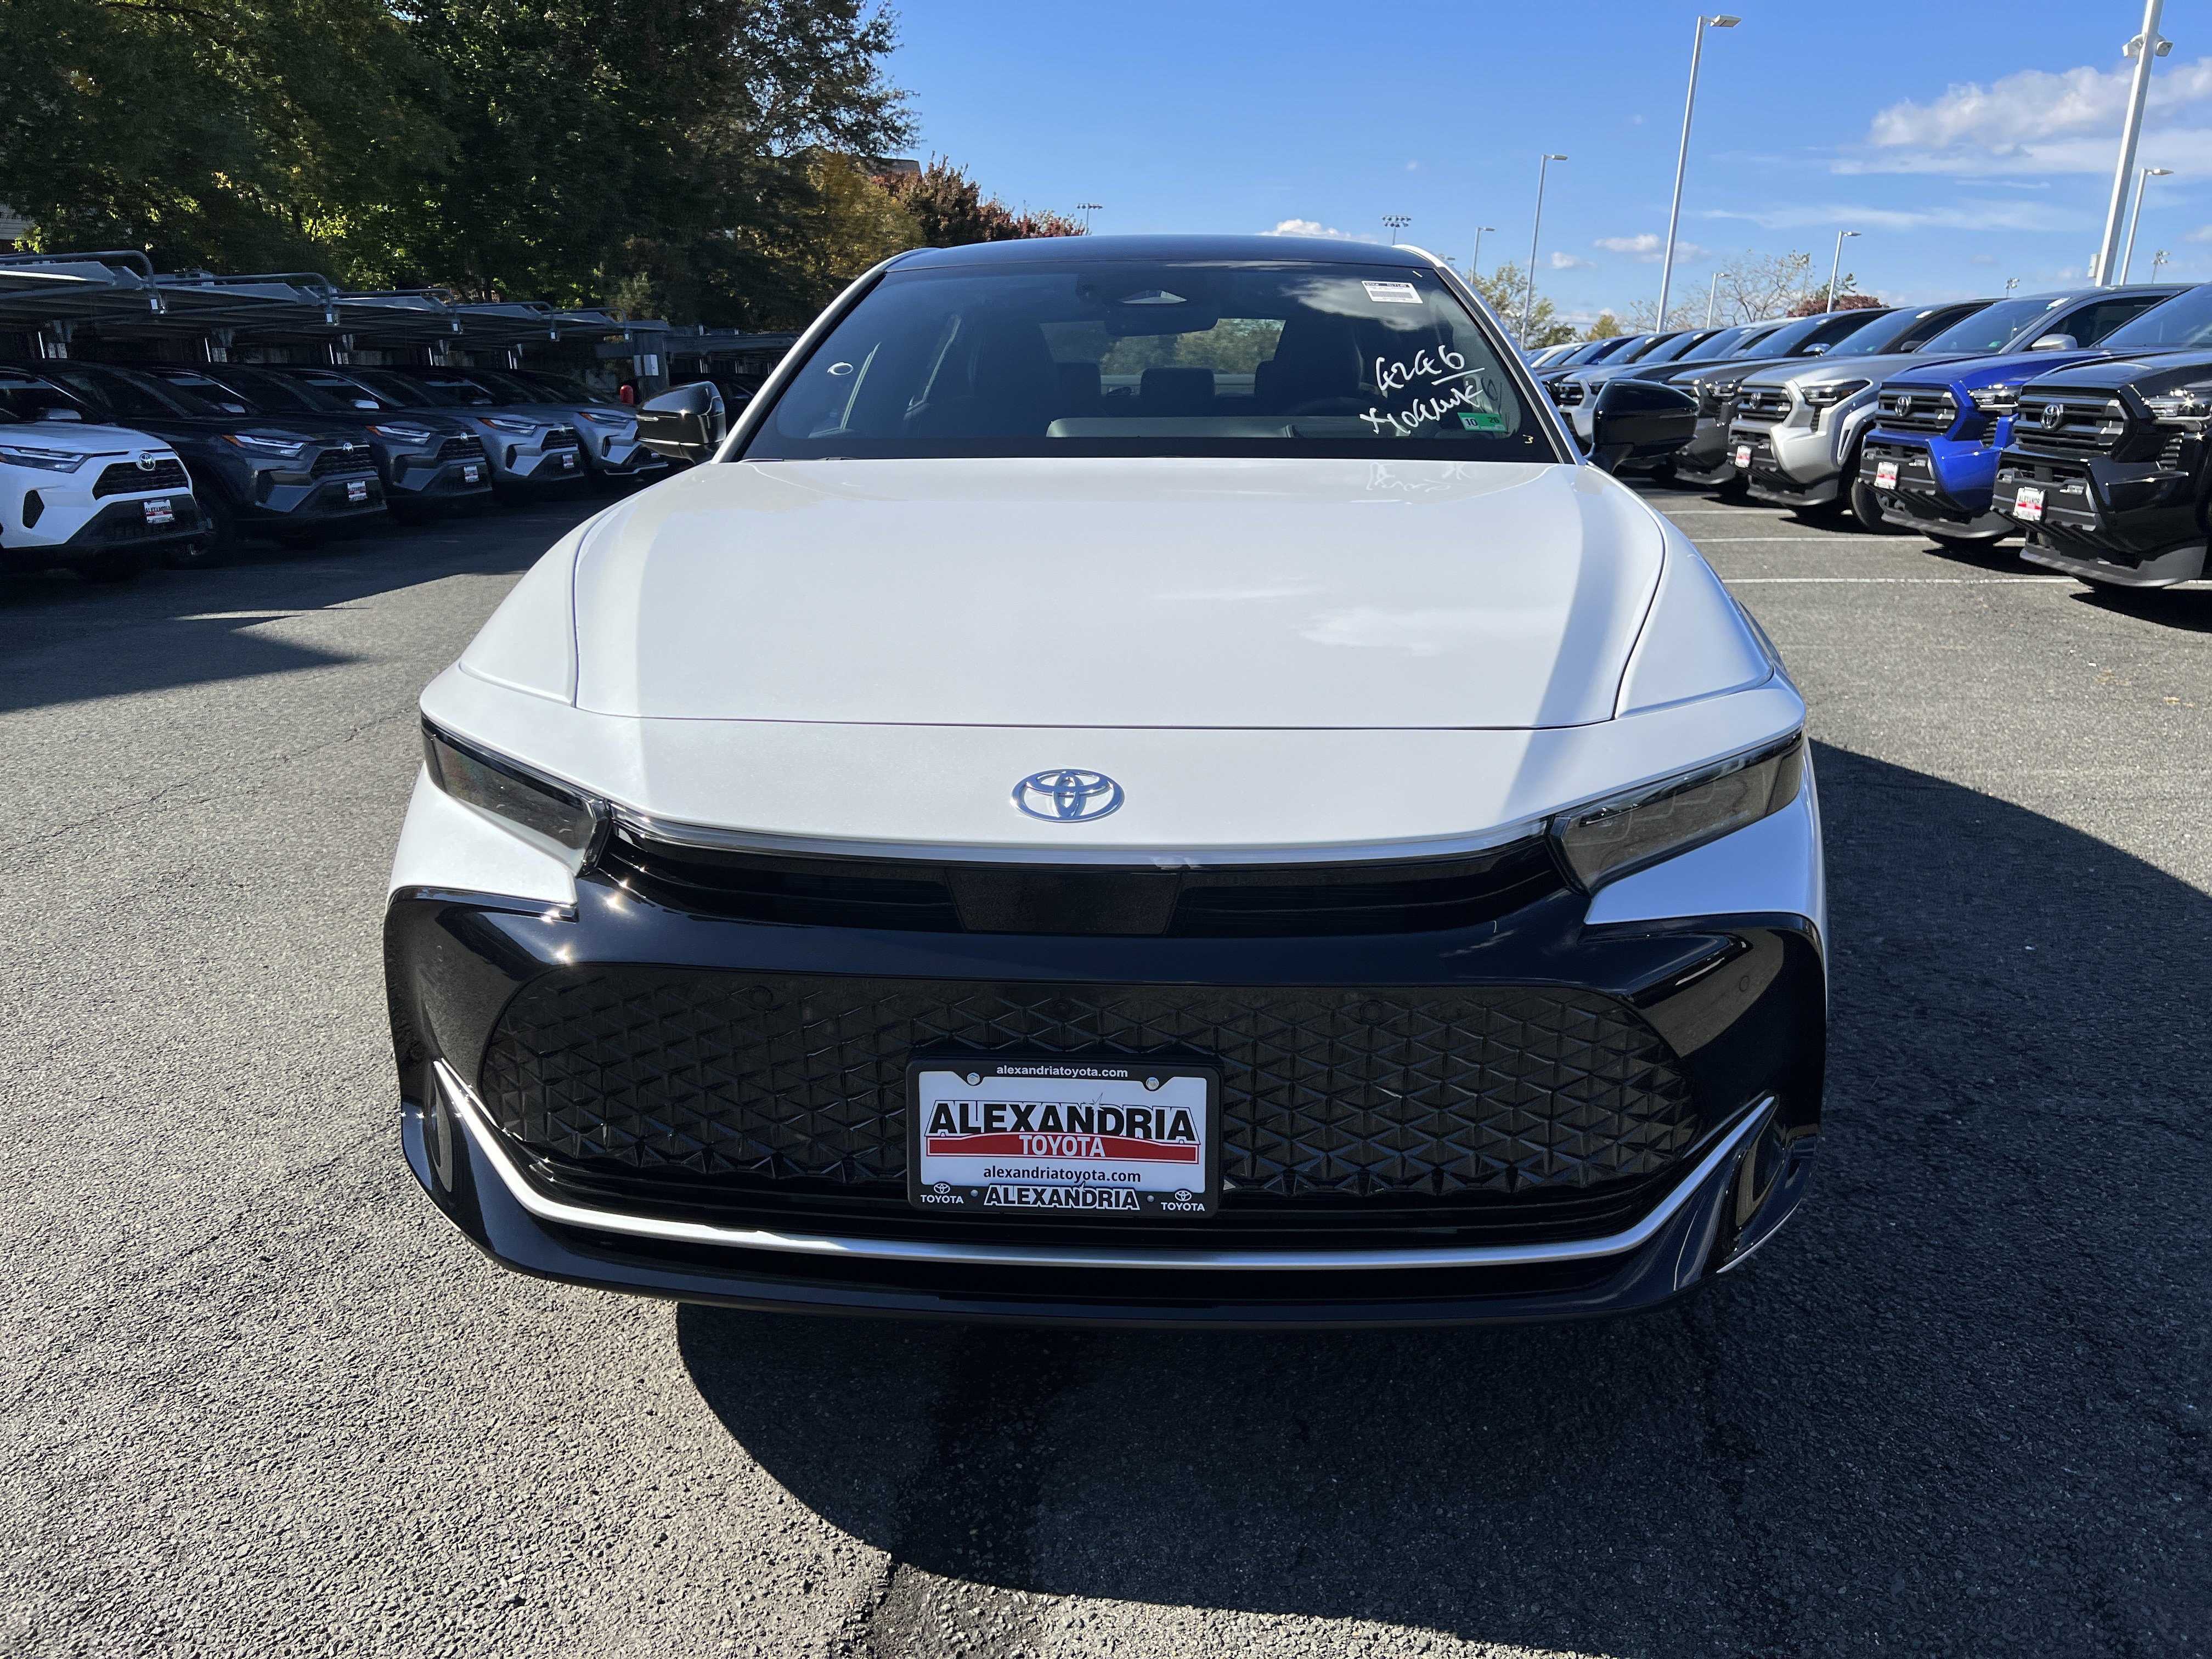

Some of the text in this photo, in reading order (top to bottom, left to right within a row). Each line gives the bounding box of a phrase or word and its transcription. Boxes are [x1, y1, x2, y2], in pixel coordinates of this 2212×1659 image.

[1465, 418, 1479, 426] 10
[996, 1065, 1128, 1077] alexandriatoyota.com
[928, 1102, 1197, 1142] ALEXANDRIA
[1019, 1134, 1106, 1158] TOYOTA
[983, 1165, 1141, 1183] alexandriatoyota.com
[921, 1194, 964, 1204] TOYOTA
[985, 1185, 1139, 1210] ALEXANDRIA
[1161, 1201, 1205, 1212] TOYOTA
